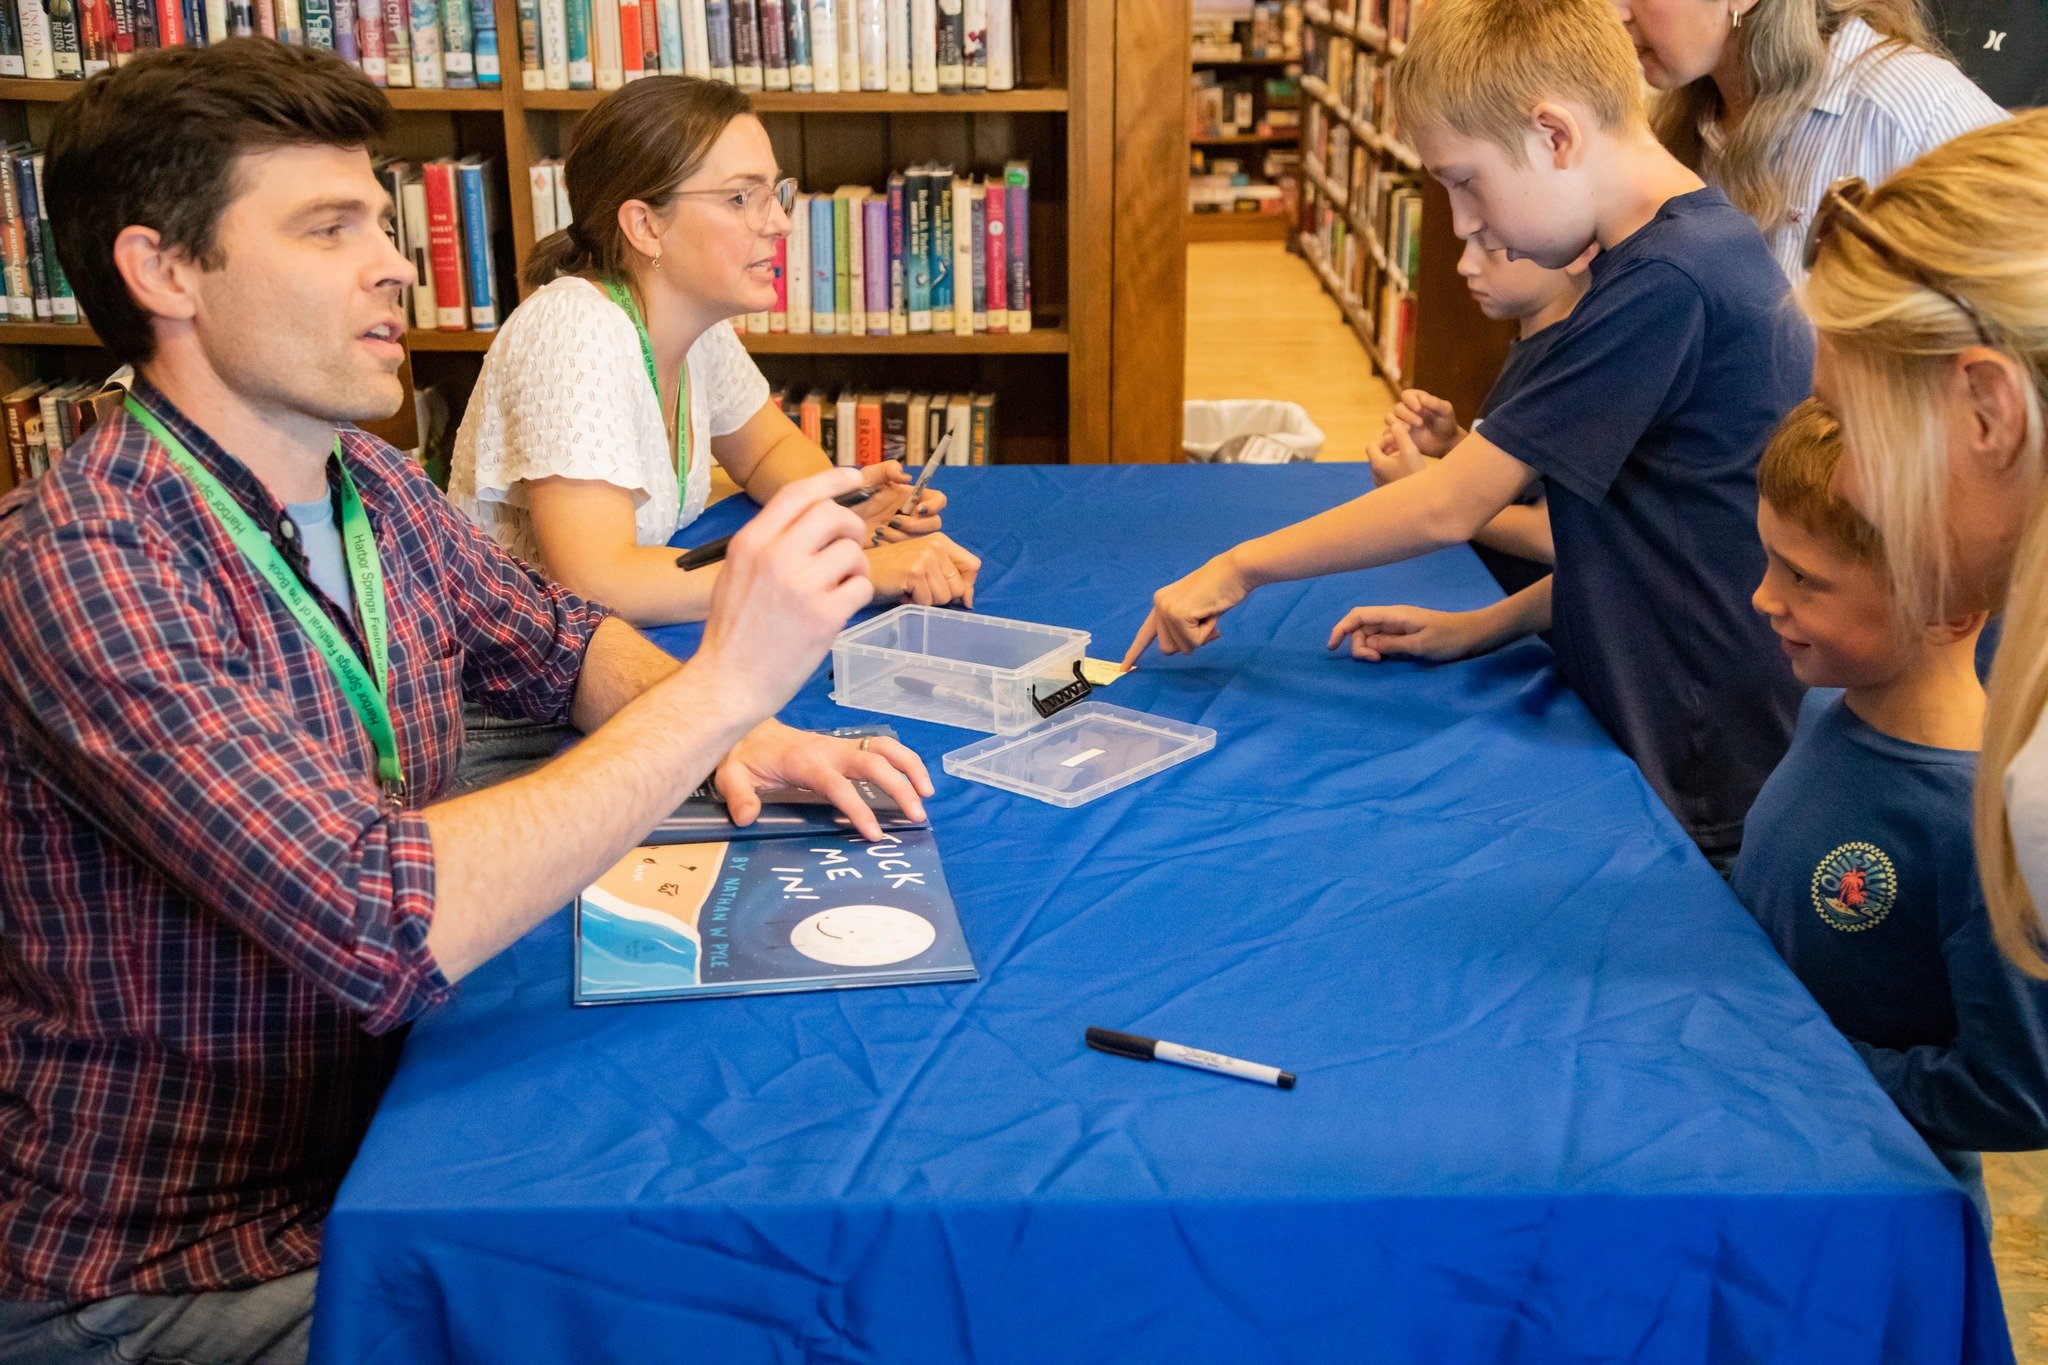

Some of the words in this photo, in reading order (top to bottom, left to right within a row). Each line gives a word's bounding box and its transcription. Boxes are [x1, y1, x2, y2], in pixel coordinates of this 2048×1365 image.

[28, 1, 43, 57] LINCOLN
[85, 12, 93, 36] OMEGA
[115, 0, 127, 35] ENDETTA
[51, 21, 64, 53] BERRY
[63, 22, 78, 53] STEVE
[0, 161, 10, 190] MAEVE
[5, 193, 14, 224] BINCHY
[9, 227, 20, 265] MINDING
[211, 500, 247, 536] Harbor
[267, 560, 291, 590] Book
[353, 533, 369, 569] Harbor
[361, 571, 377, 614] Springs
[370, 616, 384, 662] Festival
[309, 616, 337, 659] Festival
[335, 654, 363, 693] Springs
[356, 691, 380, 727] Harbor
[730, 856, 749, 873] BY
[808, 846, 864, 883] ME
[849, 832, 926, 889] TUCK
[712, 877, 742, 922] NATHAN
[770, 865, 821, 901] IN!
[709, 924, 726, 938] W
[708, 942, 730, 969] PYLE
